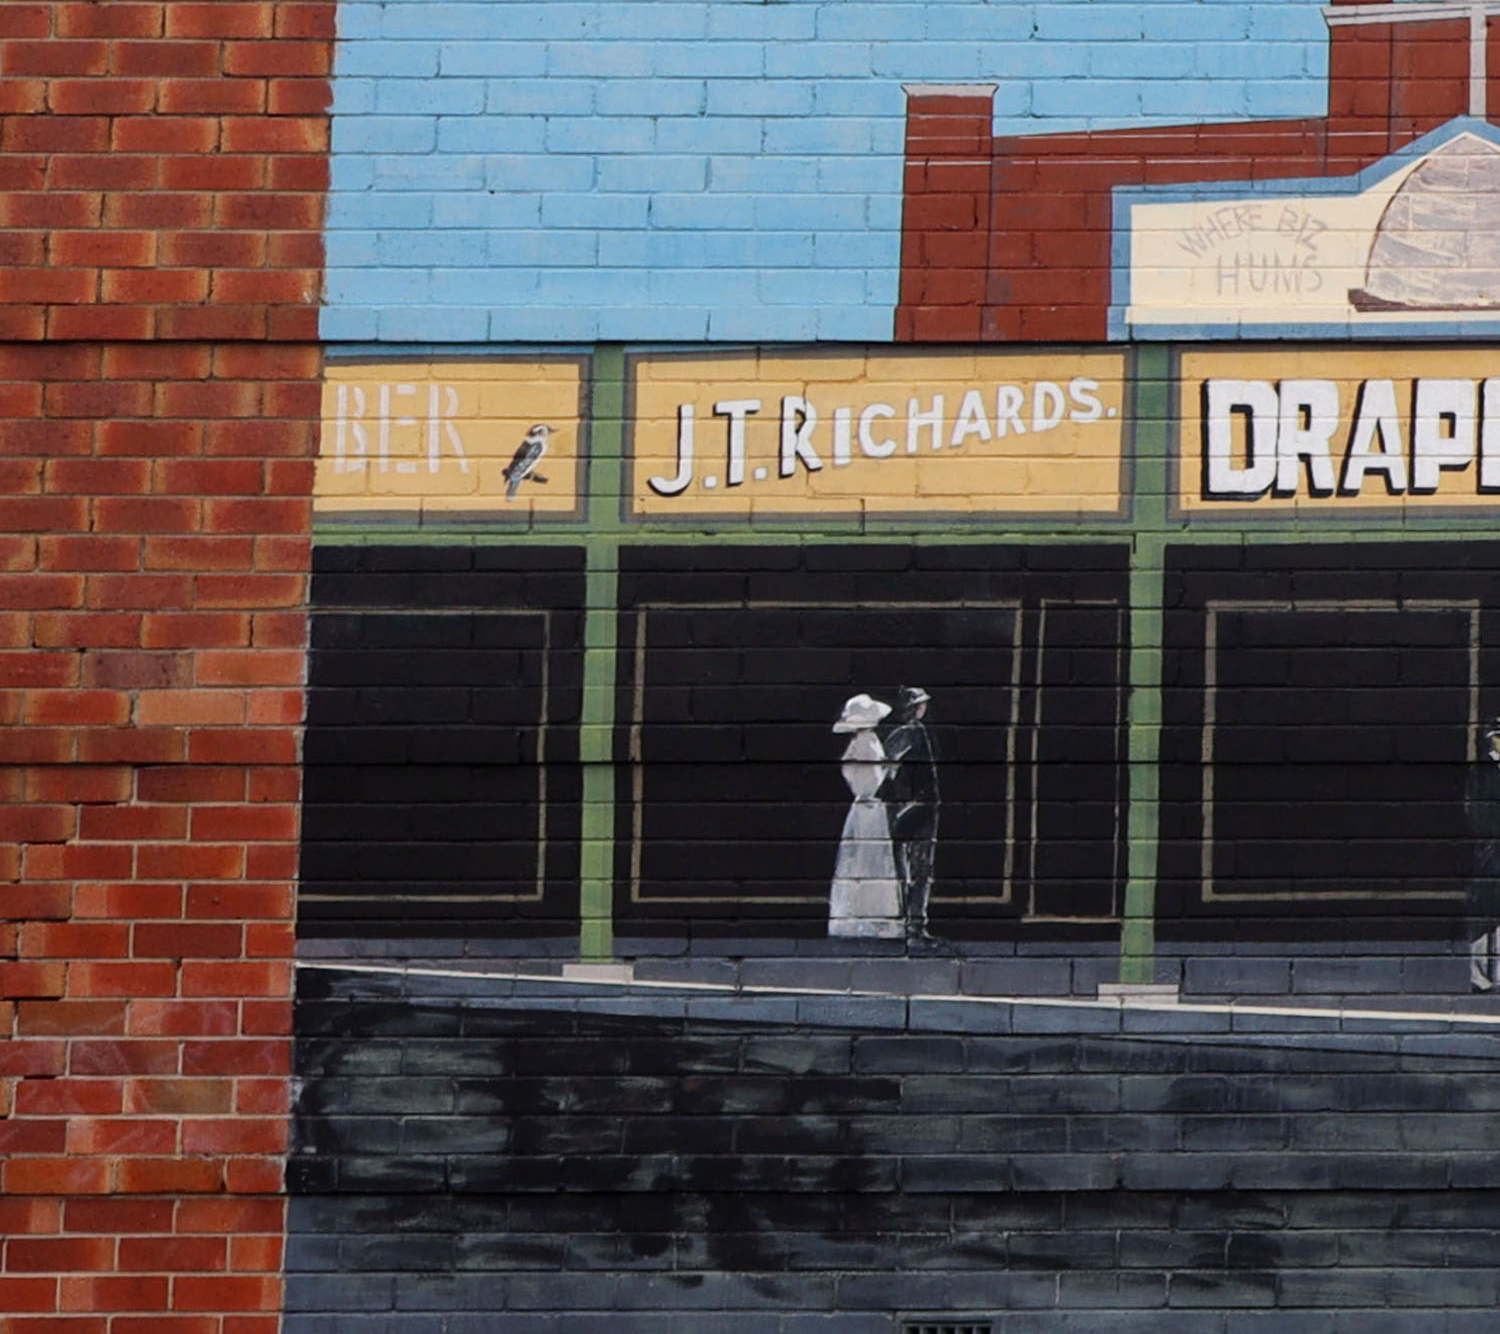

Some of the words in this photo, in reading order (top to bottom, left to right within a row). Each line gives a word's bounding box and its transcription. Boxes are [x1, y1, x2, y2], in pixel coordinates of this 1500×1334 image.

[1177, 204, 1264, 258] WHERE
[1216, 253, 1324, 295] HUMS
[334, 383, 470, 474] BER
